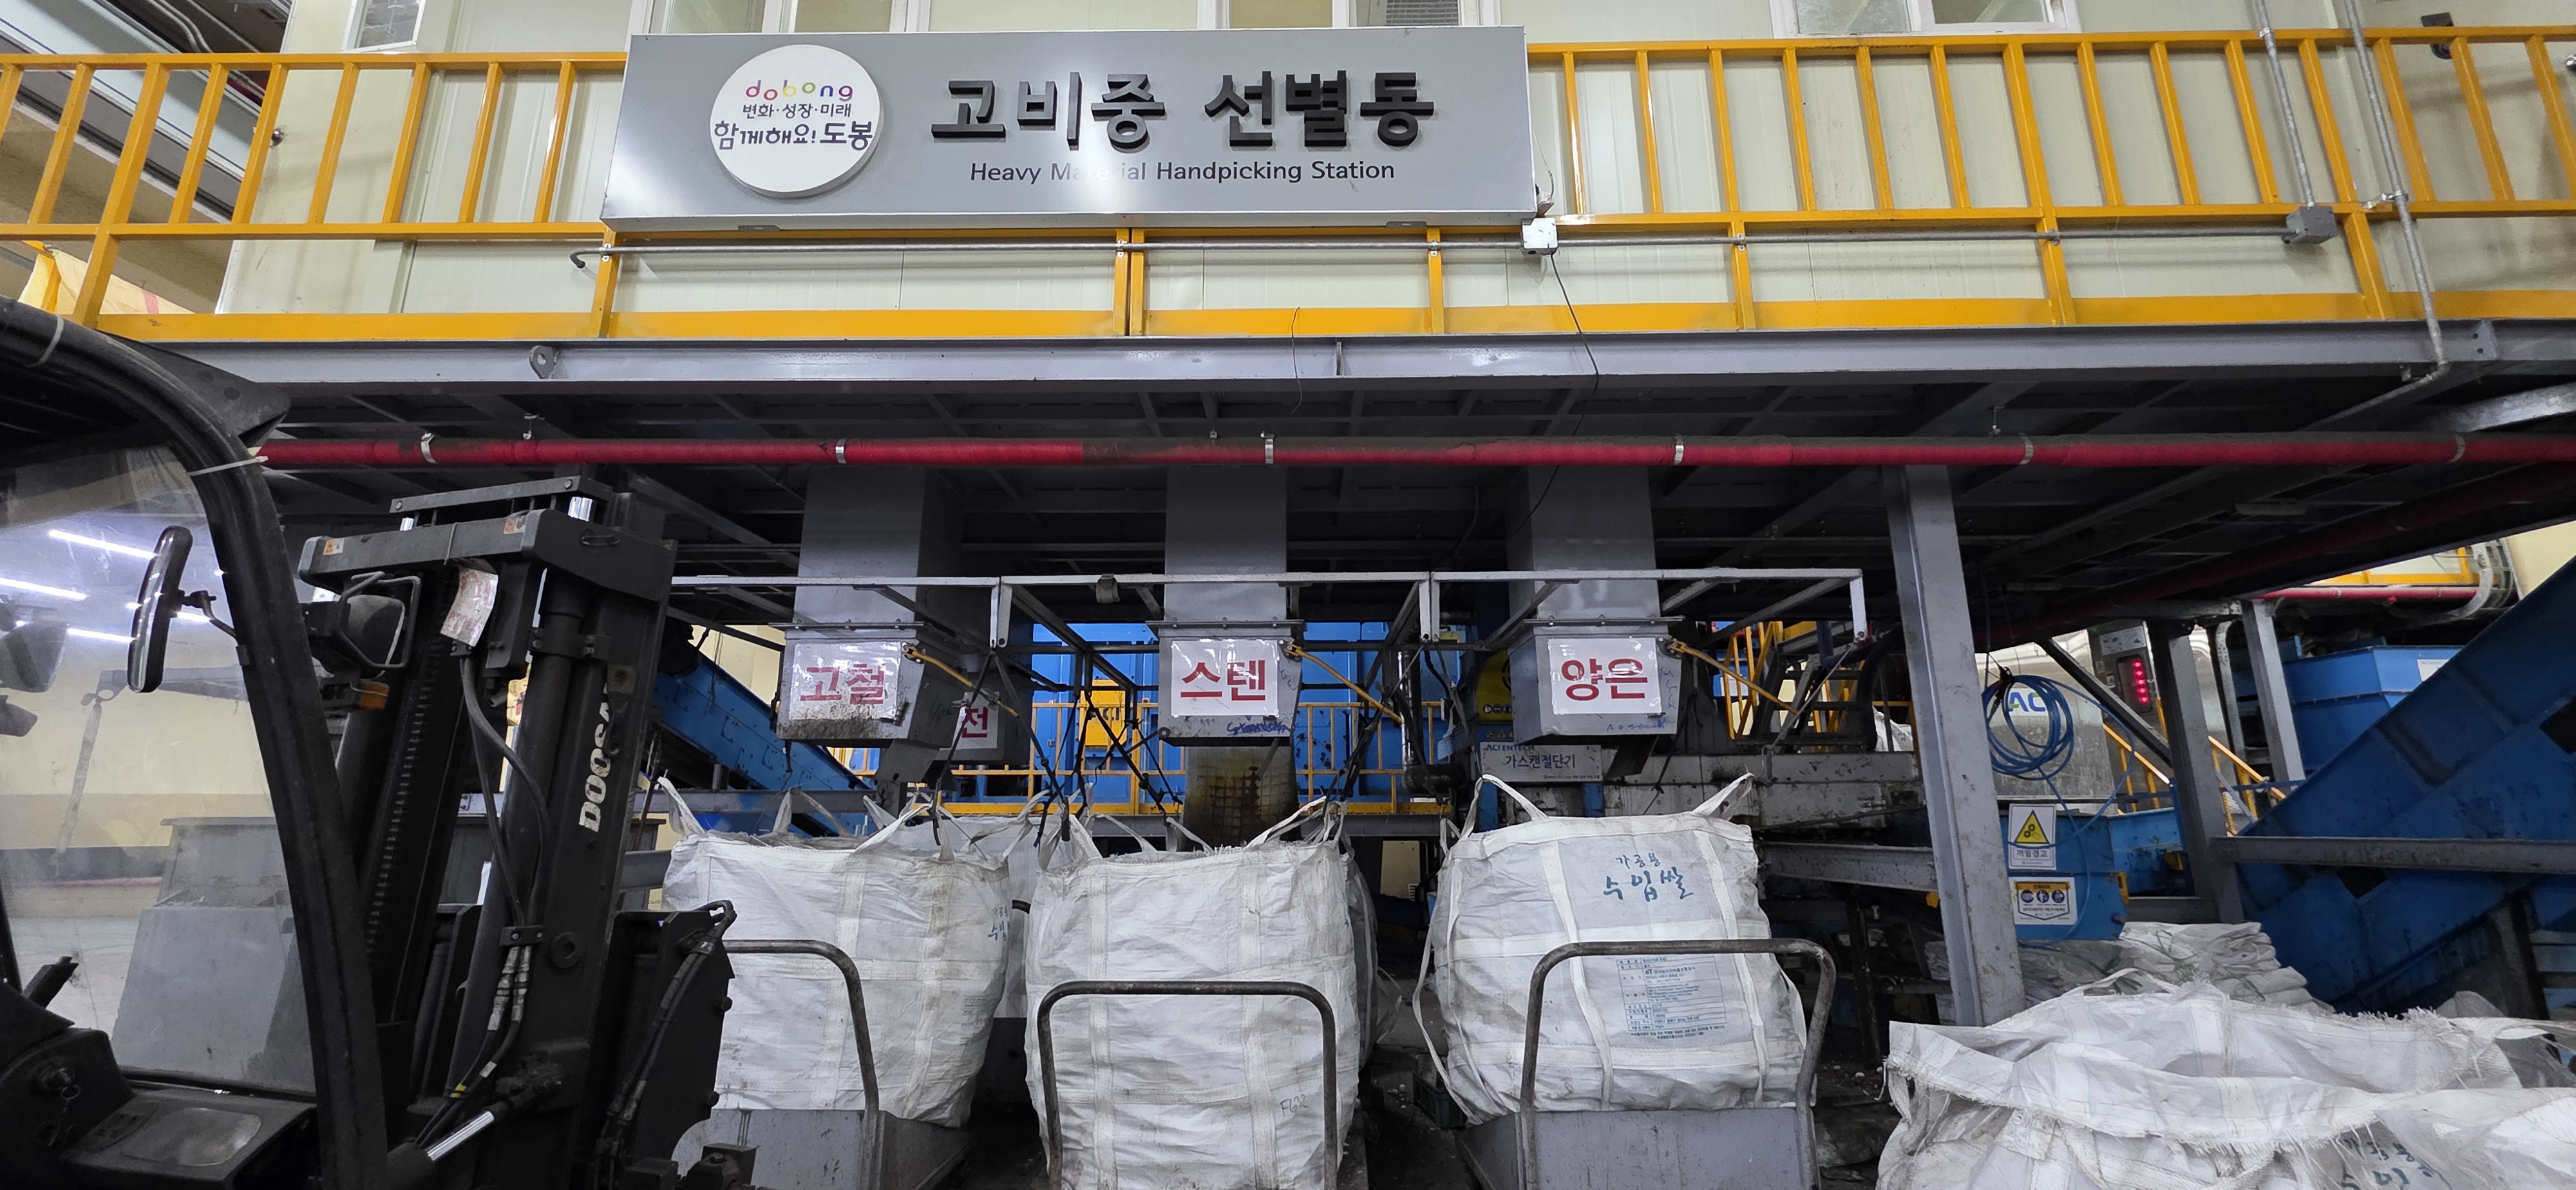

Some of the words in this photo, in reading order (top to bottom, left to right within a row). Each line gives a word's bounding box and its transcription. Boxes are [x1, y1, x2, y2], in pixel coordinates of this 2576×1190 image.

[745, 79, 853, 102] dobong
[743, 103, 852, 119] 변화·성장·미래
[931, 71, 1166, 150] 고비중
[1204, 69, 1435, 147] 선별동
[714, 120, 816, 150] 함께해요!
[819, 120, 873, 151] 도봉
[970, 162, 1042, 185] Heavy
[1157, 161, 1302, 184] Handpicking
[1311, 160, 1395, 180] Station
[800, 663, 884, 705] 고철
[1180, 659, 1266, 702] 스텐
[1560, 657, 1649, 701] 양은
[1505, 753, 1576, 769] 가스캔절단기
[1603, 866, 1694, 902] 수입쌀
